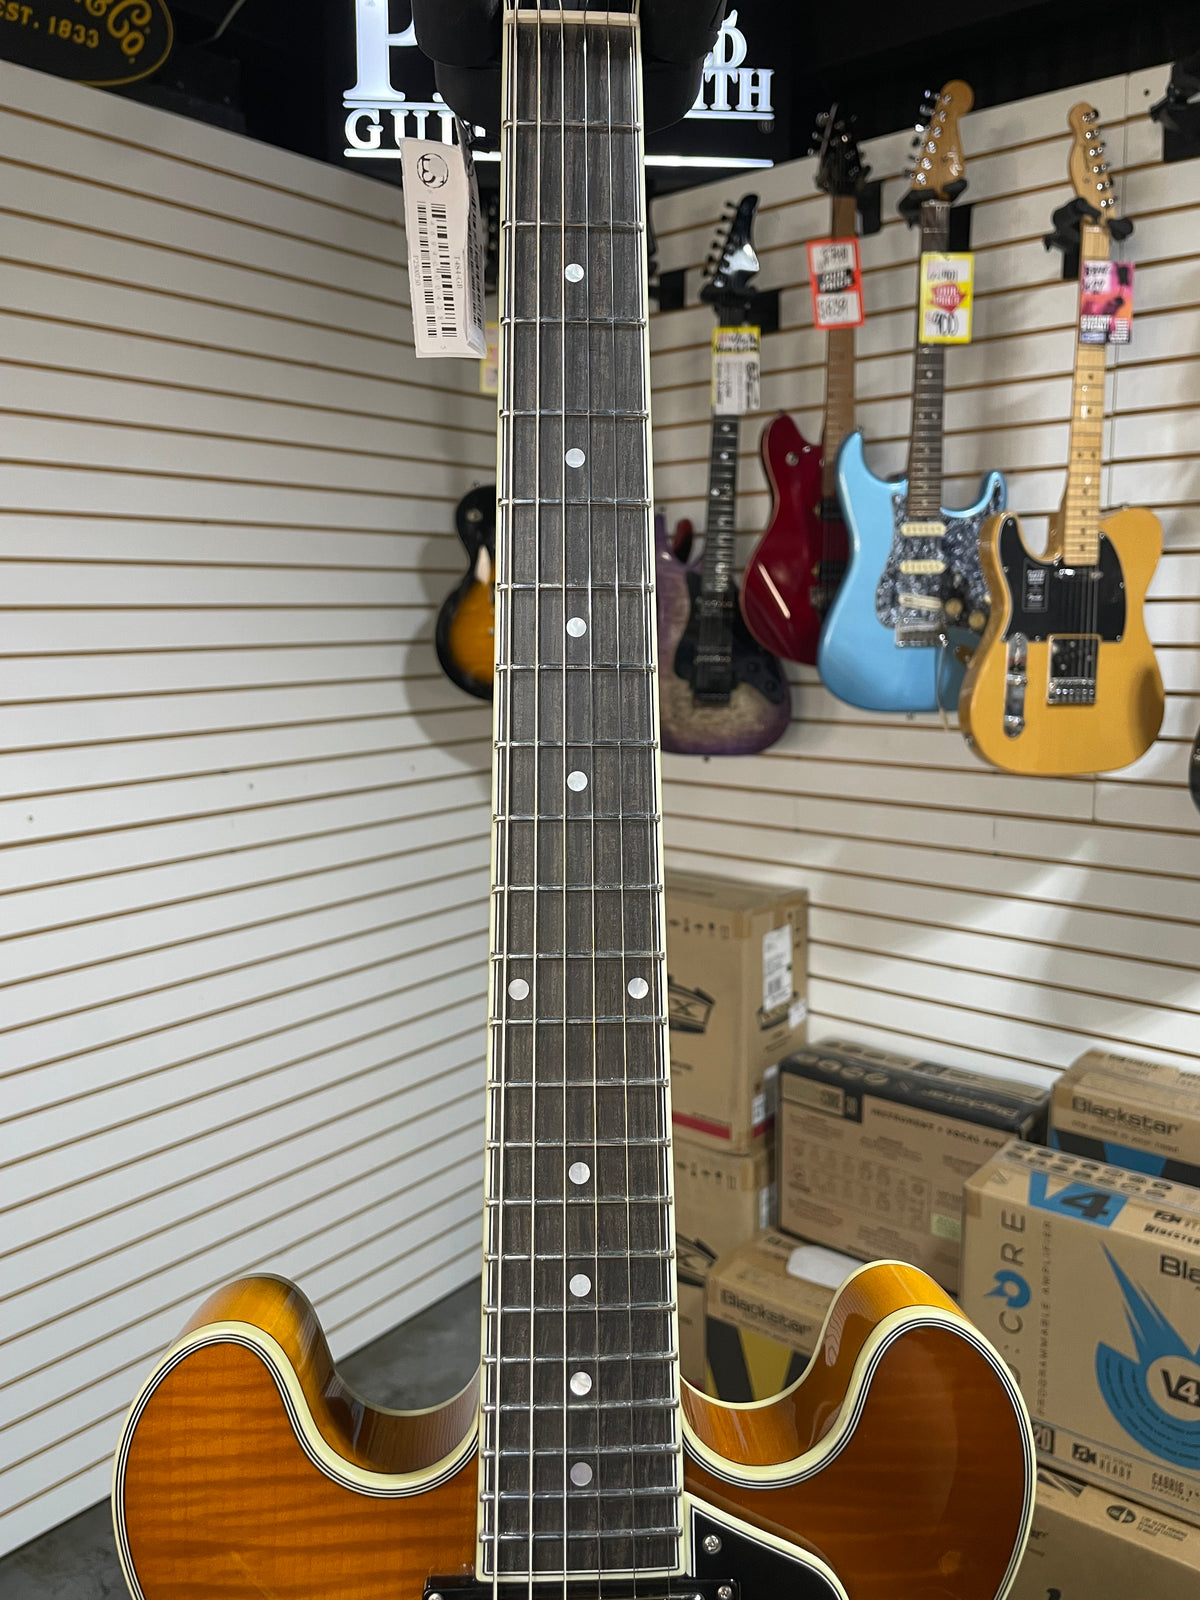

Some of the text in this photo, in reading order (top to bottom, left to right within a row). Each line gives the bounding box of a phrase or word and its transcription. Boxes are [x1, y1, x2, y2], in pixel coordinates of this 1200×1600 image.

[0, 2, 99, 48] ST. 1833
[1071, 1096, 1182, 1136] Blackstar
[720, 1289, 811, 1335] Blackstar
